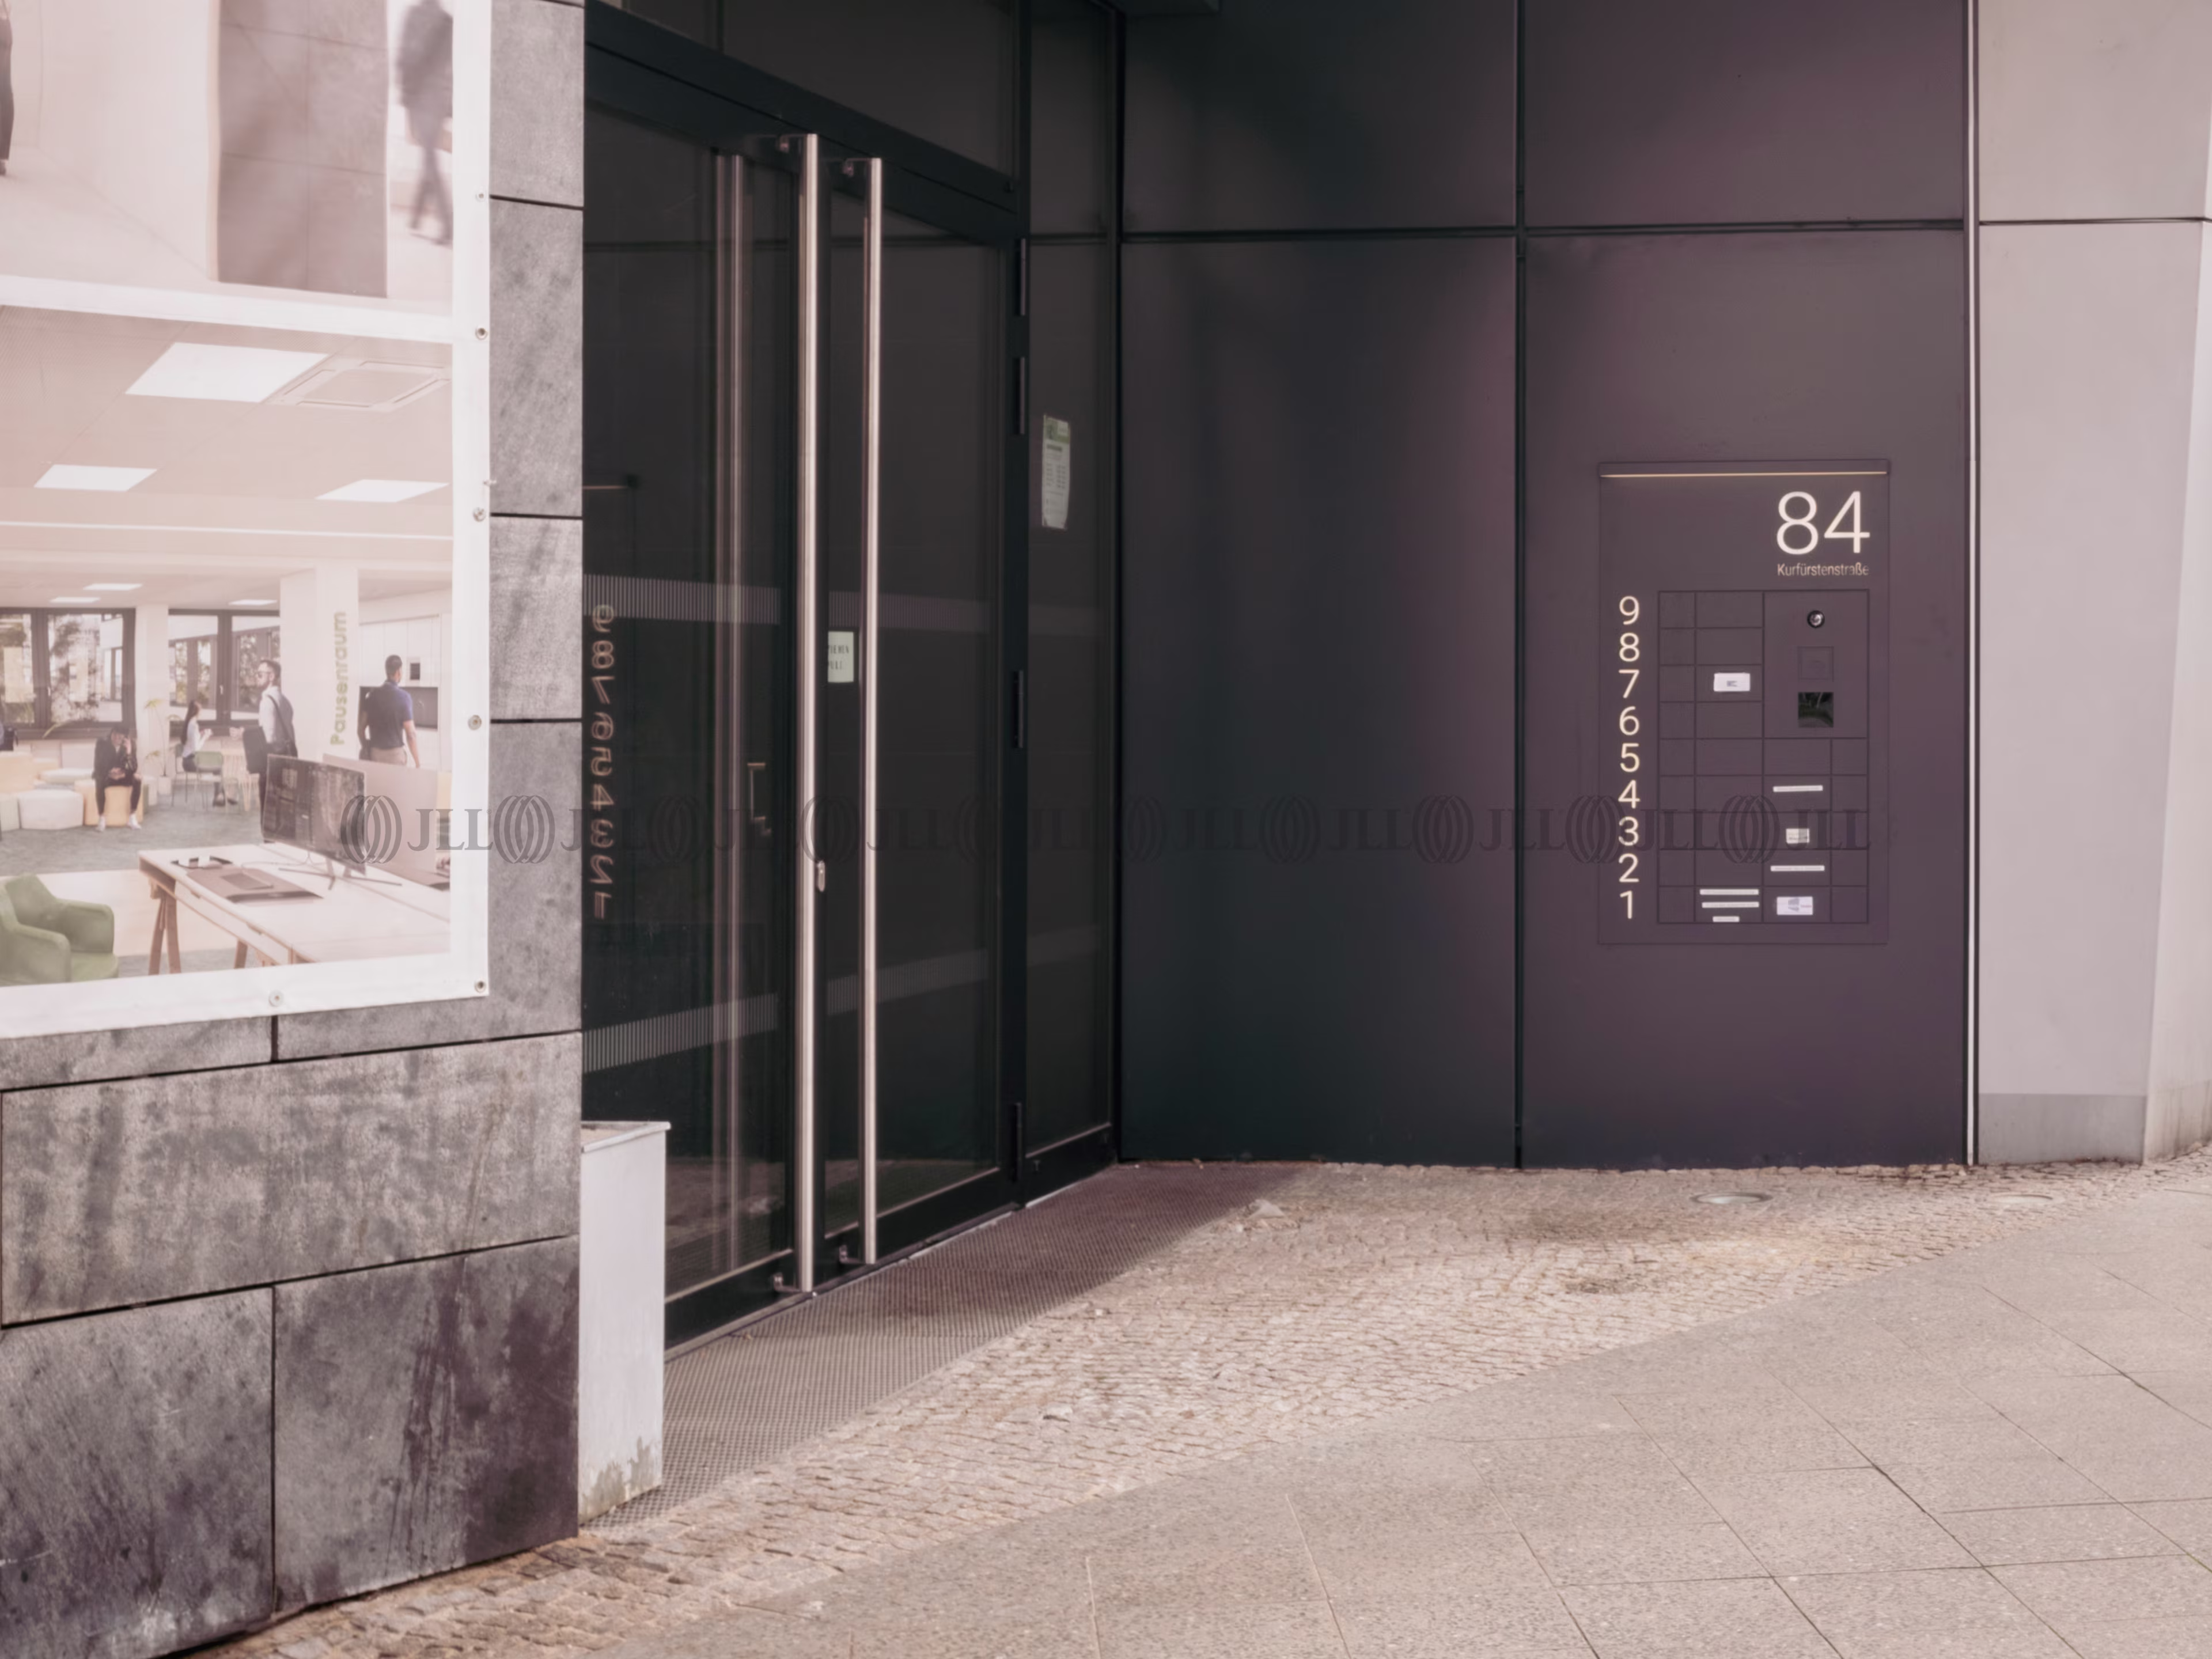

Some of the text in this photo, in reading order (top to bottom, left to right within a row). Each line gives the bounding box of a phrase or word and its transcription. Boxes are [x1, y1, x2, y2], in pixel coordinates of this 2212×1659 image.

[1776, 490, 1870, 555] 84
[1777, 561, 1869, 577] Kurfürstenstraße
[1619, 596, 1640, 626] 9
[1619, 632, 1640, 662] 8
[330, 611, 348, 745] Pausenraum
[1618, 669, 1640, 699] 7
[1619, 706, 1640, 736] 6
[1620, 743, 1640, 773] 5
[1618, 779, 1641, 809] 4
[1618, 816, 1639, 846] 3
[1618, 853, 1639, 883] 2
[1620, 890, 1633, 919] 1
